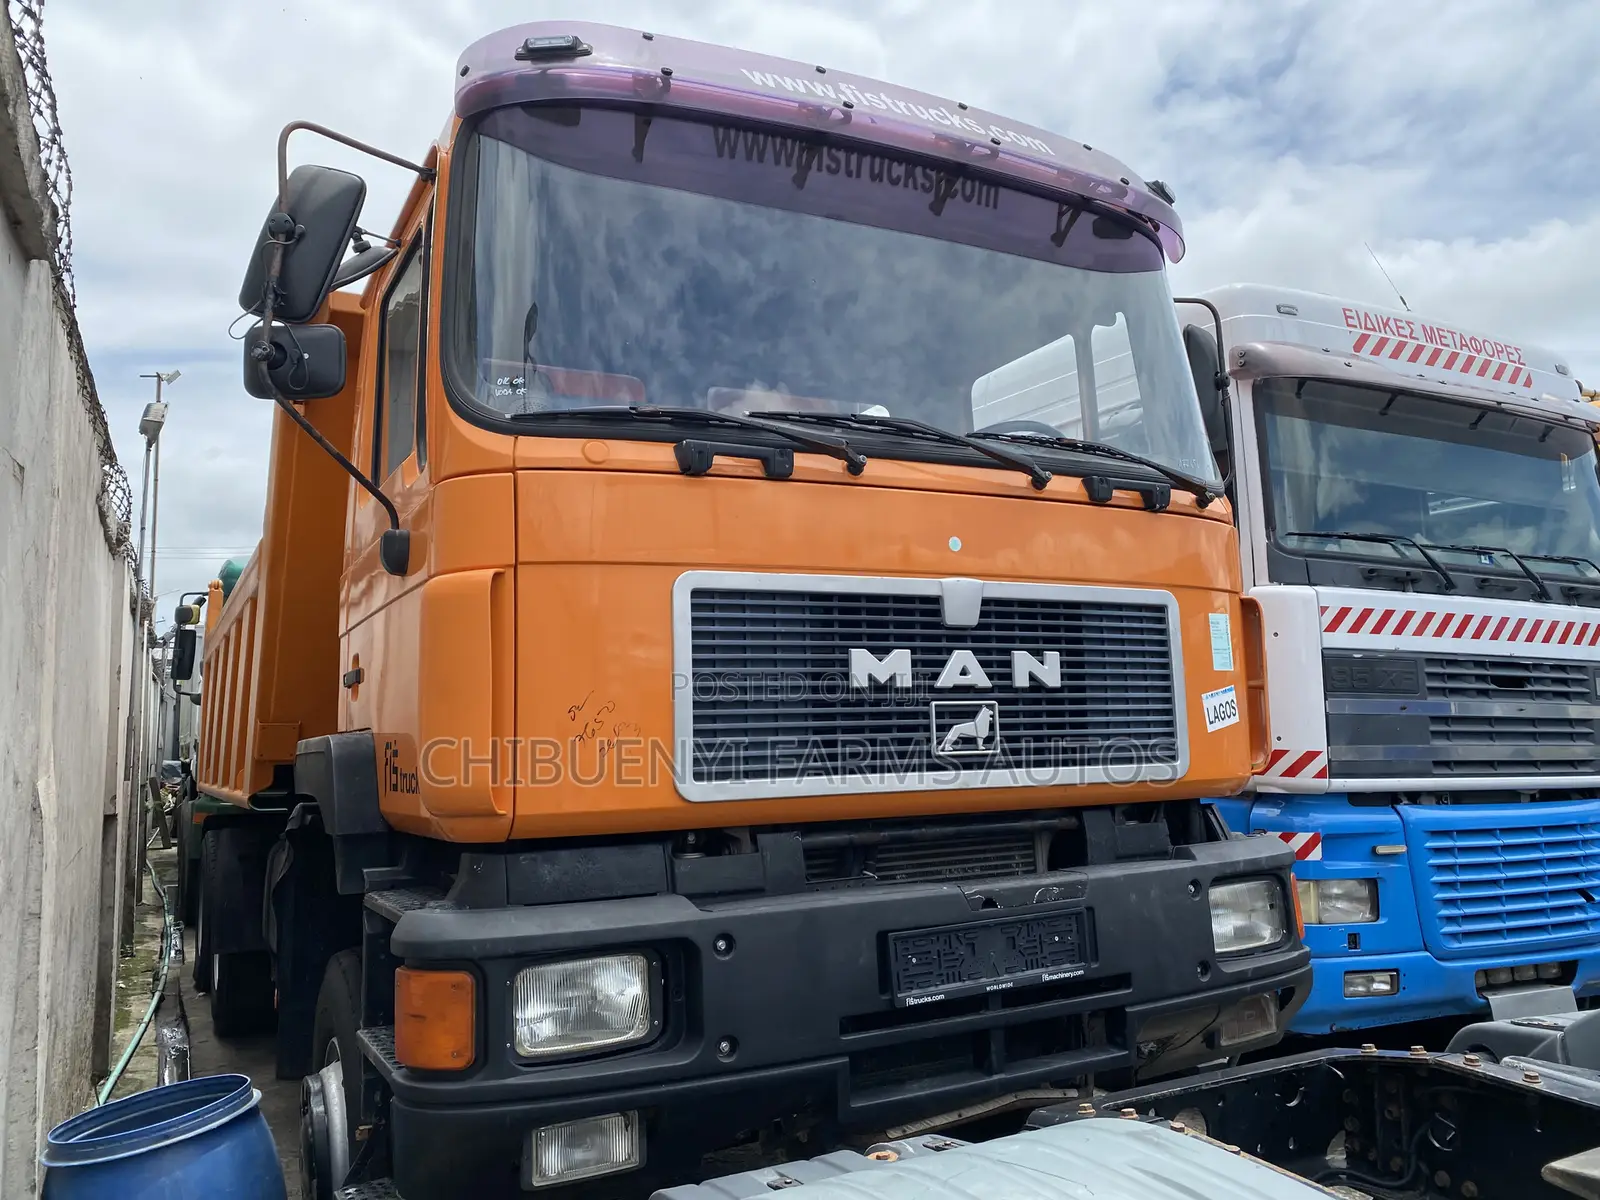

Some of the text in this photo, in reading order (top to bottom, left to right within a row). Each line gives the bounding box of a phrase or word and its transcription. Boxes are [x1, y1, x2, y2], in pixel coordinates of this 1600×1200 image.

[740, 67, 1056, 156] www.fistrucks.com
[1341, 307, 1526, 366] ΕΙΔΙΚΕΣ ΜΕΤΑΦΟΡΕΣ
[848, 648, 1062, 690] MAN
[1206, 698, 1237, 725] LAGOS
[986, 981, 1014, 992] WORLDWIDE
